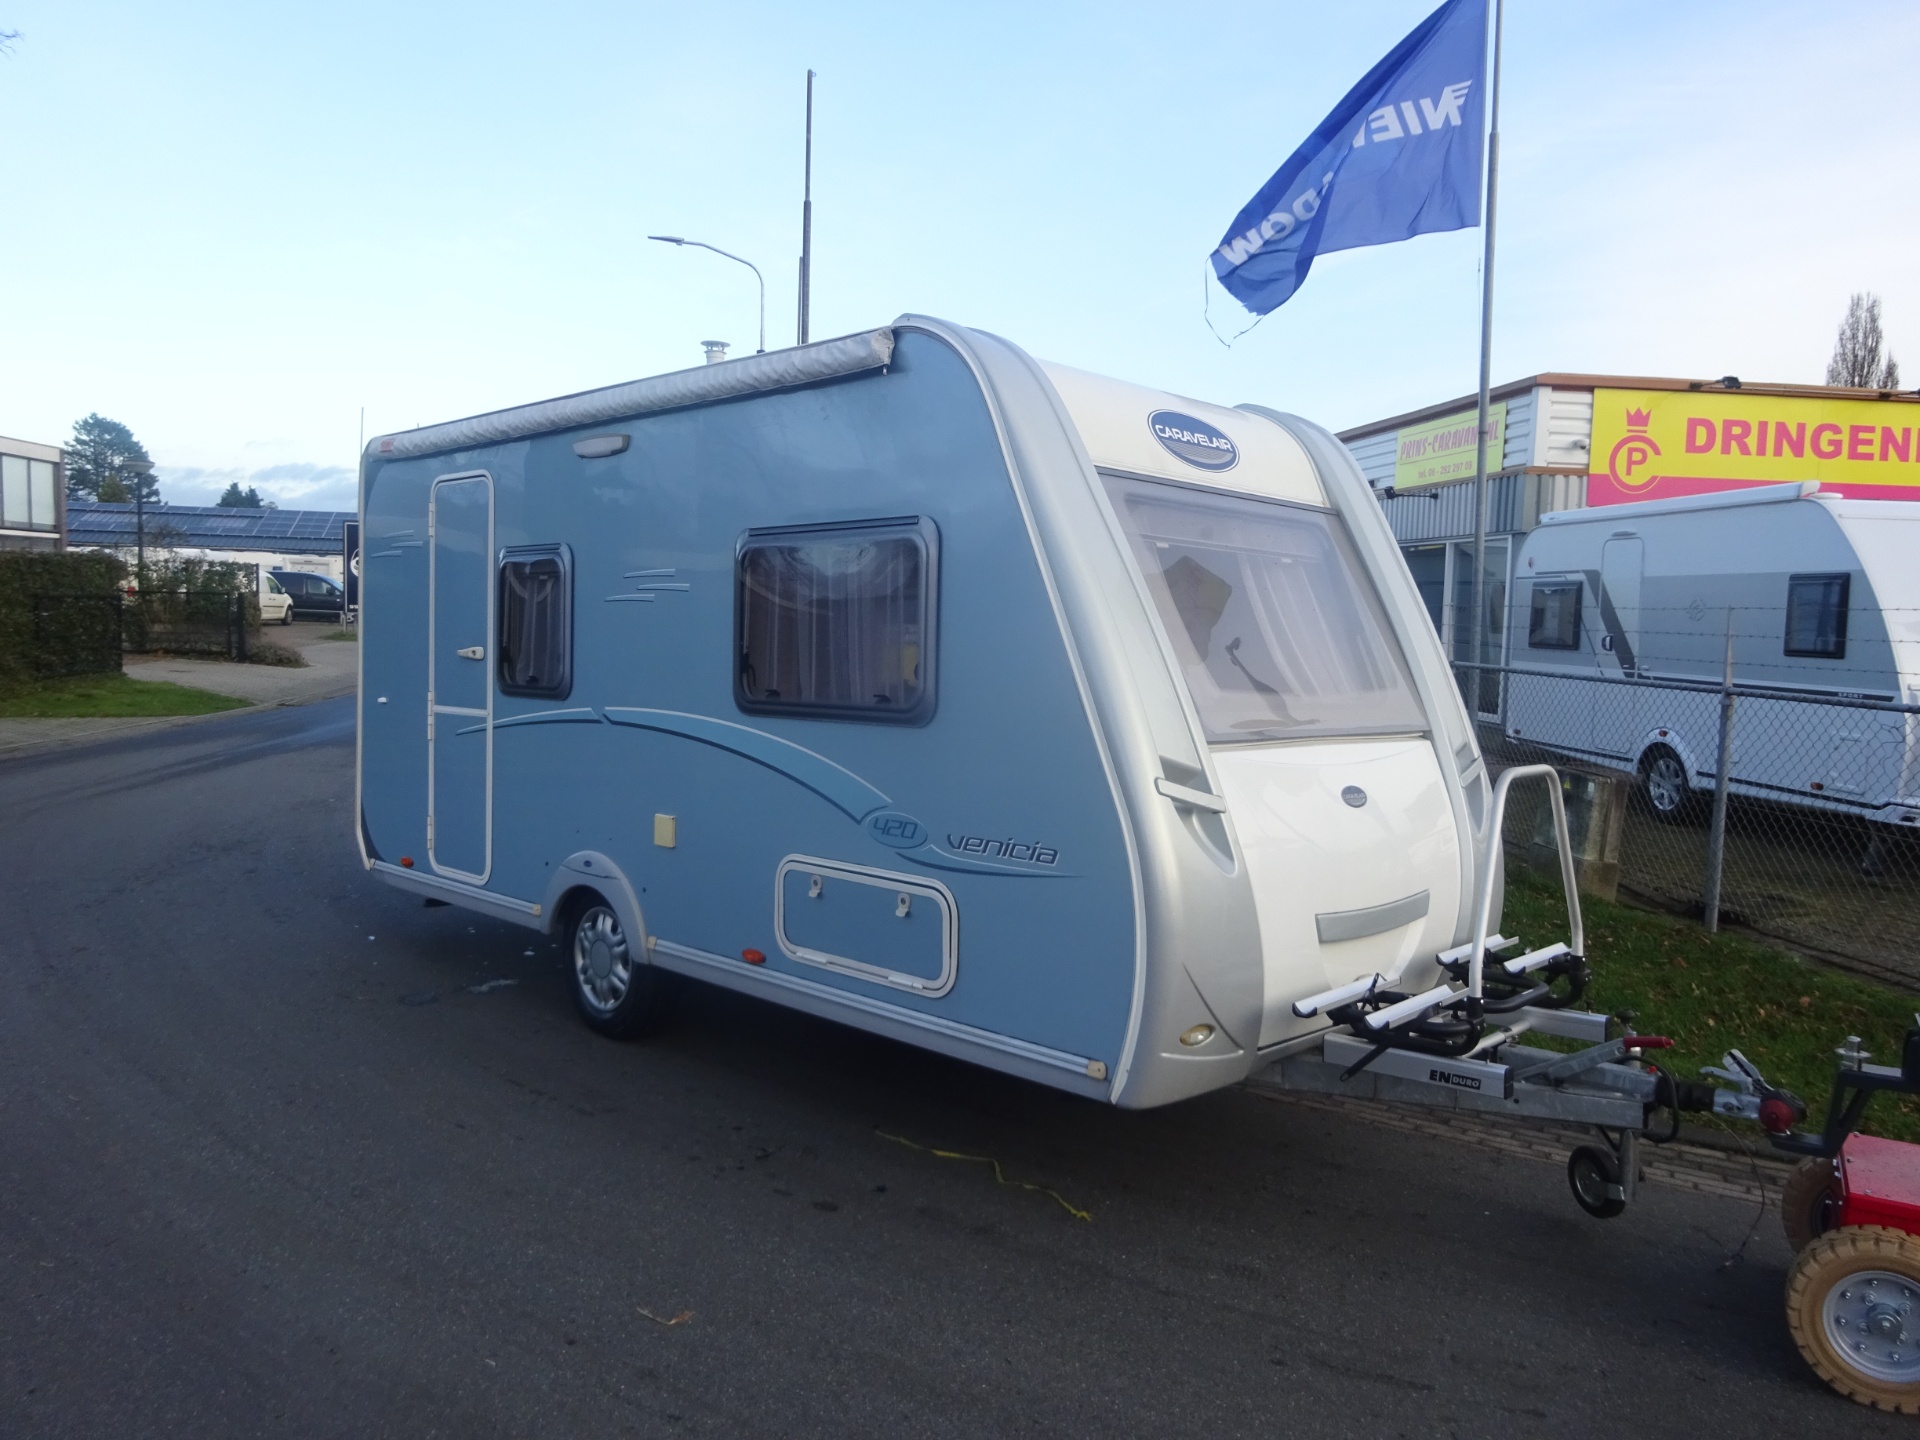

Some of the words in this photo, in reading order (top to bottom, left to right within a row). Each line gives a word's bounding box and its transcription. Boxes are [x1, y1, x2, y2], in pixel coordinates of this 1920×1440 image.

[1155, 424, 1233, 452] CARAVELAIR
[1684, 416, 1920, 464] DRINGEN
[873, 816, 918, 840] 420
[946, 832, 1060, 866] venicia
[1429, 1069, 1482, 1091] ENDURO
